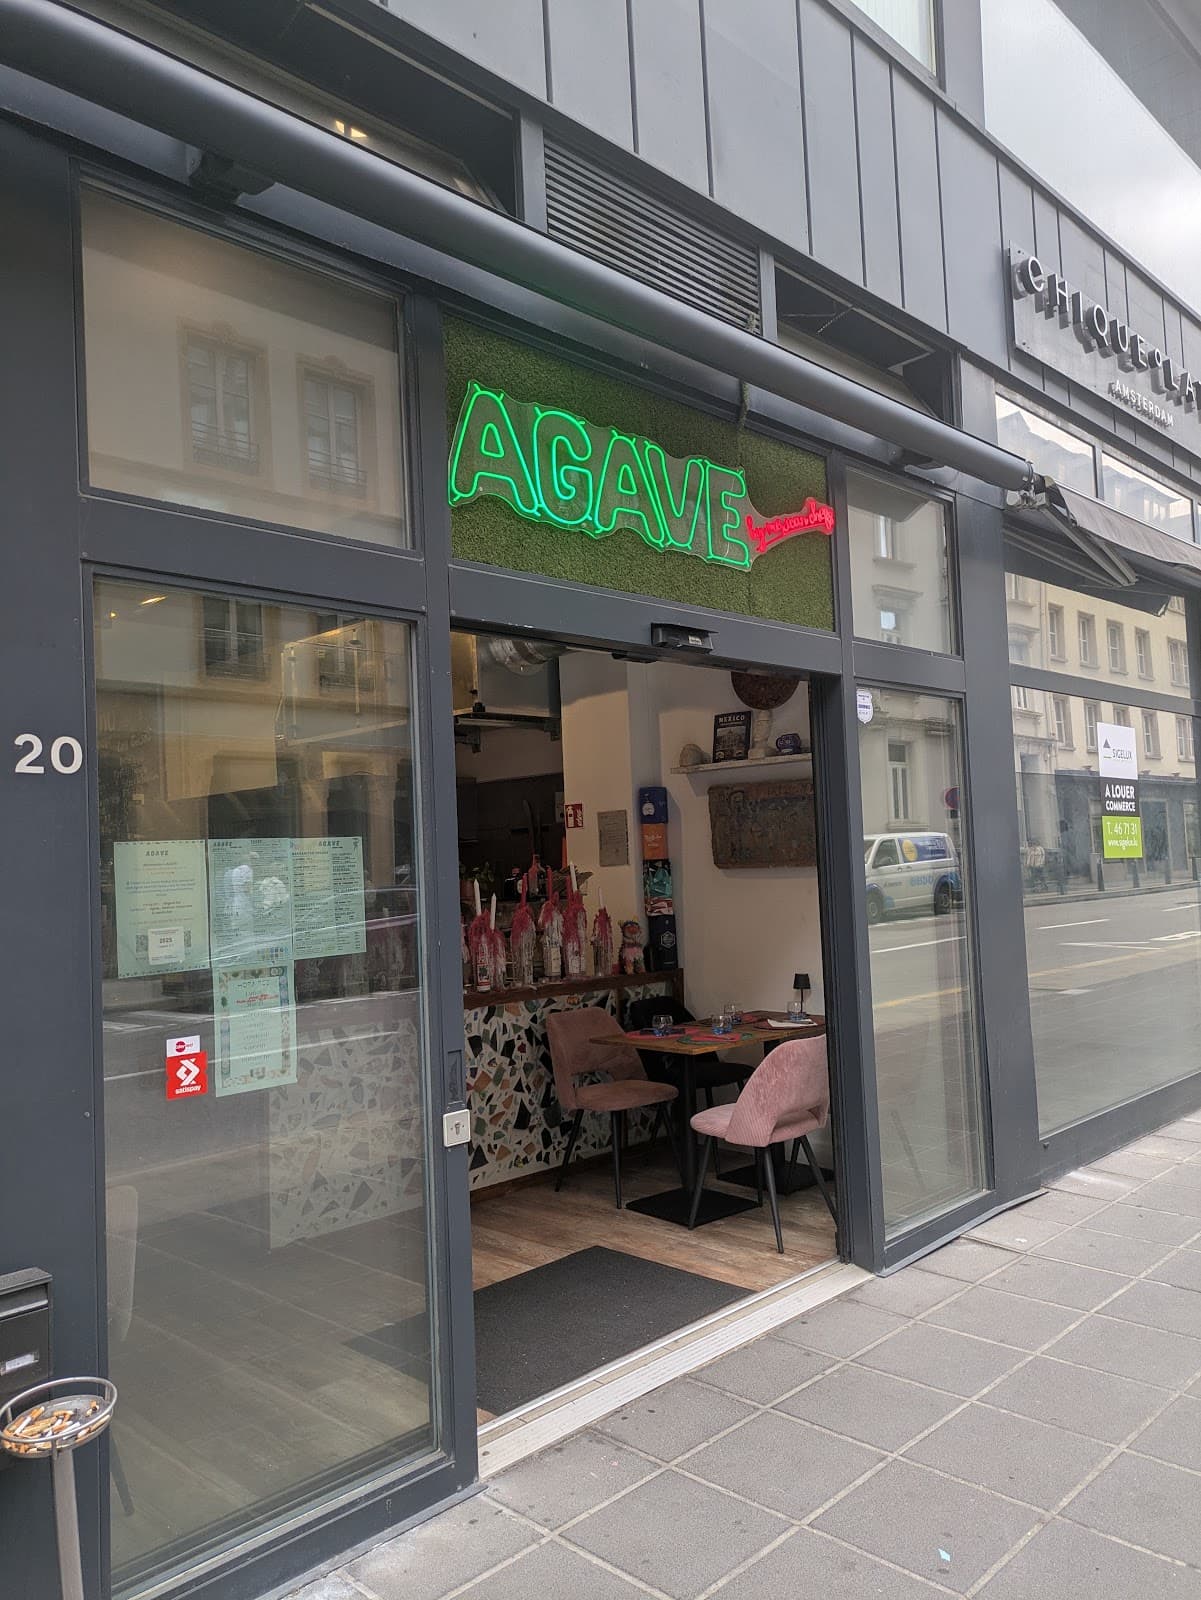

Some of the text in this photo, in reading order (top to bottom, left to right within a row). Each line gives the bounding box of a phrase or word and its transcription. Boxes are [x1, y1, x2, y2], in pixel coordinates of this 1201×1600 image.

[1113, 379, 1174, 428] AMSTERDAM
[450, 383, 750, 569] AGAVE
[718, 715, 746, 724] MEXICO
[14, 733, 83, 775] 20
[1105, 783, 1135, 800] A LOUER
[1105, 800, 1136, 813] COMMERCE
